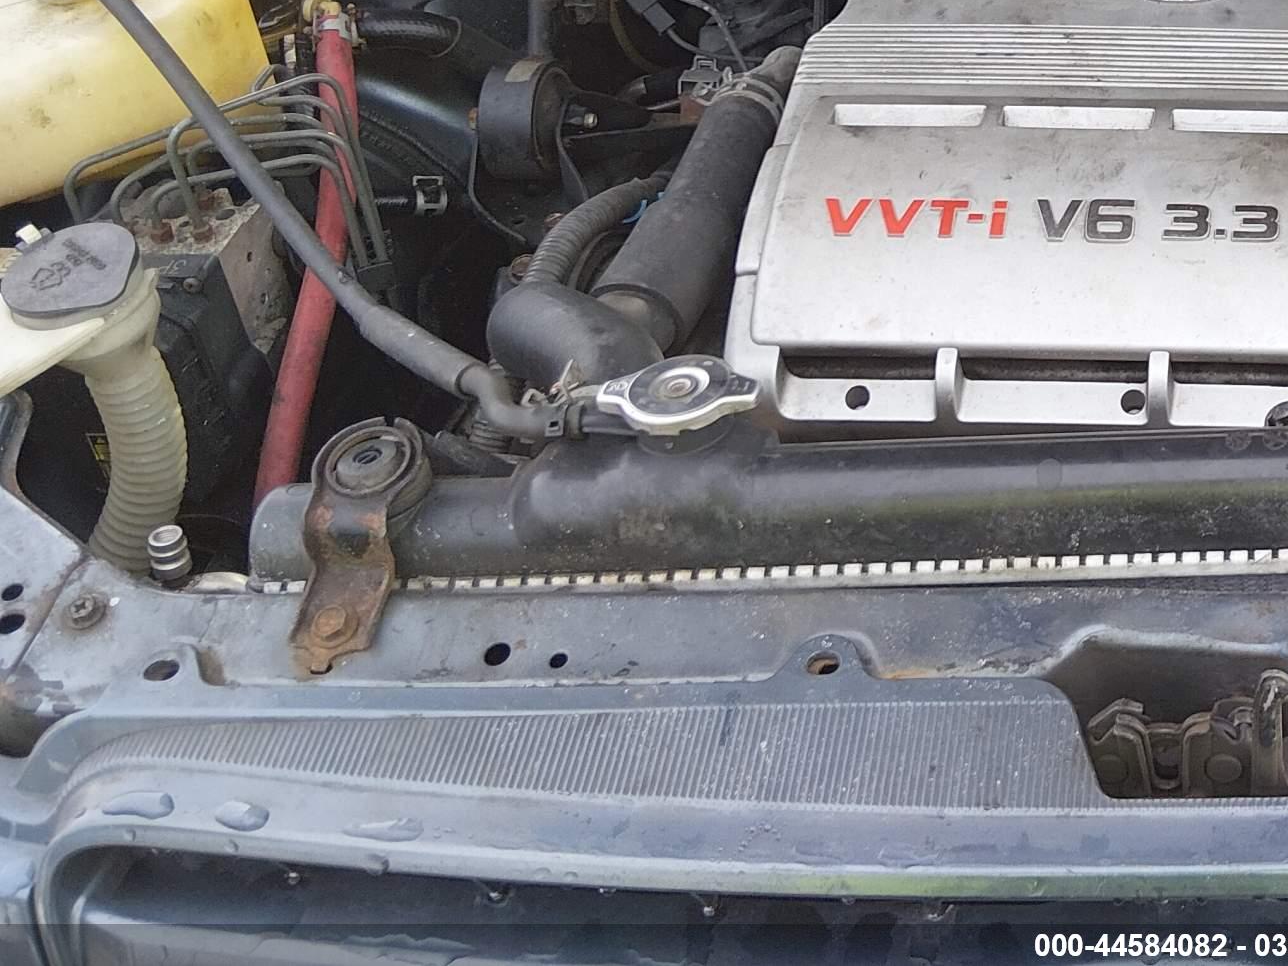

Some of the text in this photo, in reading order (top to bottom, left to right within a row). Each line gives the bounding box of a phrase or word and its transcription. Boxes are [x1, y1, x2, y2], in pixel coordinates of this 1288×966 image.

[824, 197, 1281, 243] VVT-i V6 3.3
